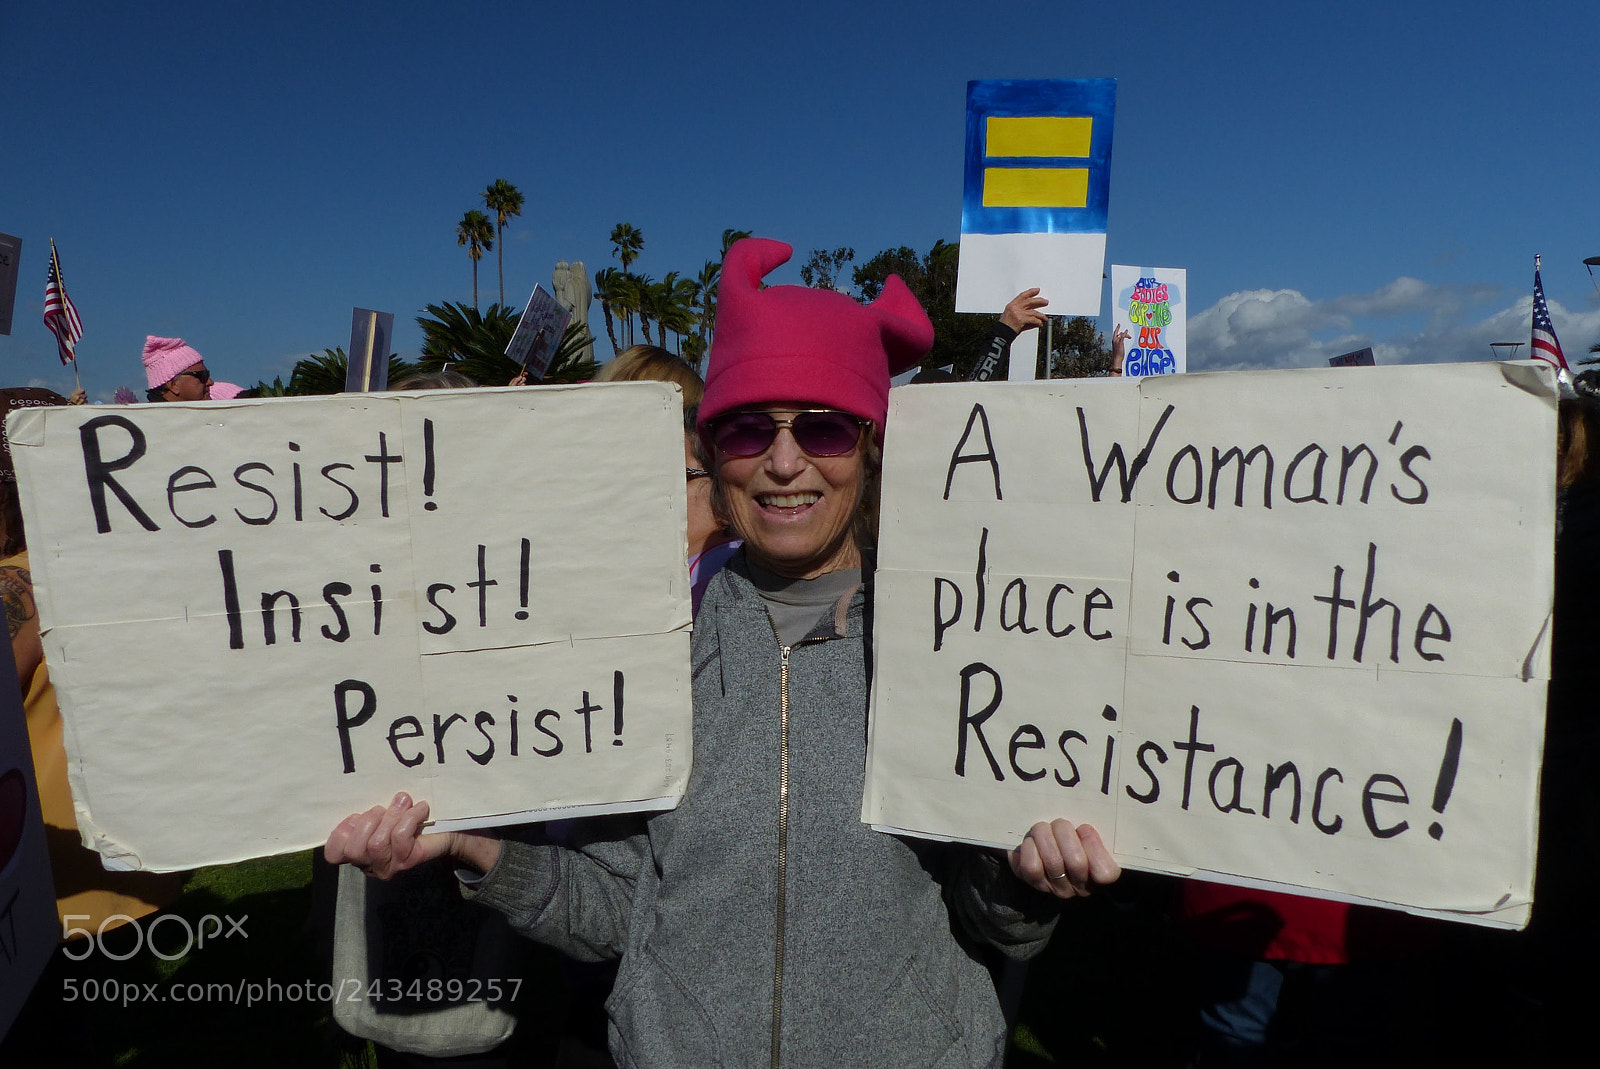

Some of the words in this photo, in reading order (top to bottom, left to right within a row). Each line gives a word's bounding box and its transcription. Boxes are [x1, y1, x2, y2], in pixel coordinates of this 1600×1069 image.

[1131, 284, 1168, 303] BODIES
[1136, 278, 1161, 288] OUR
[1138, 327, 1163, 349] OUR
[79, 415, 437, 534] Resist!
[943, 403, 1002, 500] A
[1076, 405, 1431, 510] Woman's
[218, 538, 534, 652] Insist!
[934, 527, 1113, 652] place
[1163, 571, 1213, 650] is
[1245, 578, 1296, 658] in
[1314, 542, 1451, 663] the
[334, 670, 624, 774] Persist!
[955, 662, 1462, 842] Resistance!
